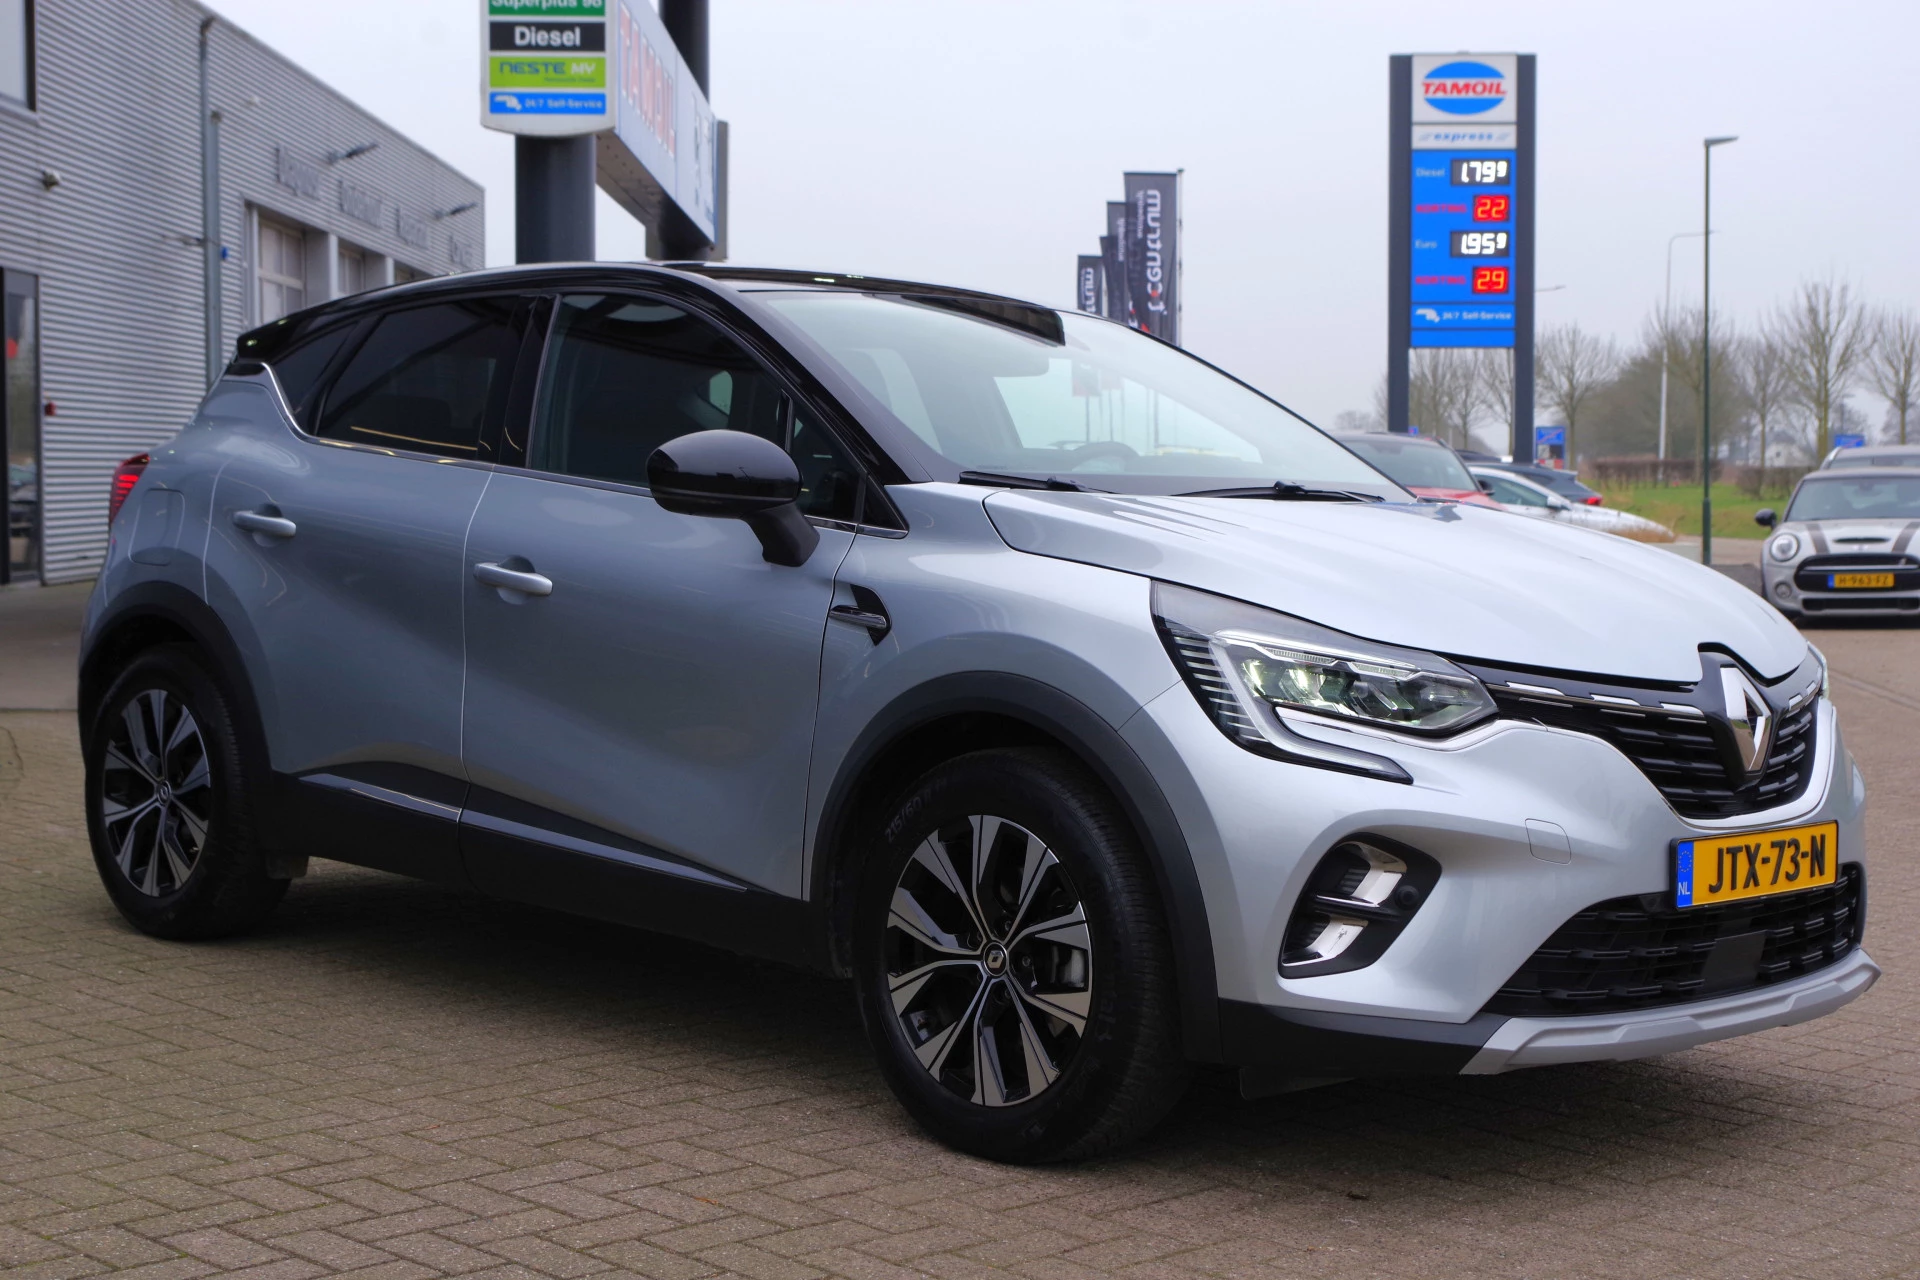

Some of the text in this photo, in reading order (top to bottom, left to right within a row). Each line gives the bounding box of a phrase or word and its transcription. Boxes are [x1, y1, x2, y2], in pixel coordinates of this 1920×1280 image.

[514, 26, 580, 47] Diesel
[571, 62, 596, 75] MY
[1421, 81, 1507, 96] TAMOIL
[1433, 132, 1494, 142] express
[1415, 167, 1446, 177] Diesel
[1476, 199, 1506, 219] 22
[1476, 270, 1505, 290] 29
[1708, 833, 1826, 894] JTX-73-N
[1678, 881, 1691, 896] NL
